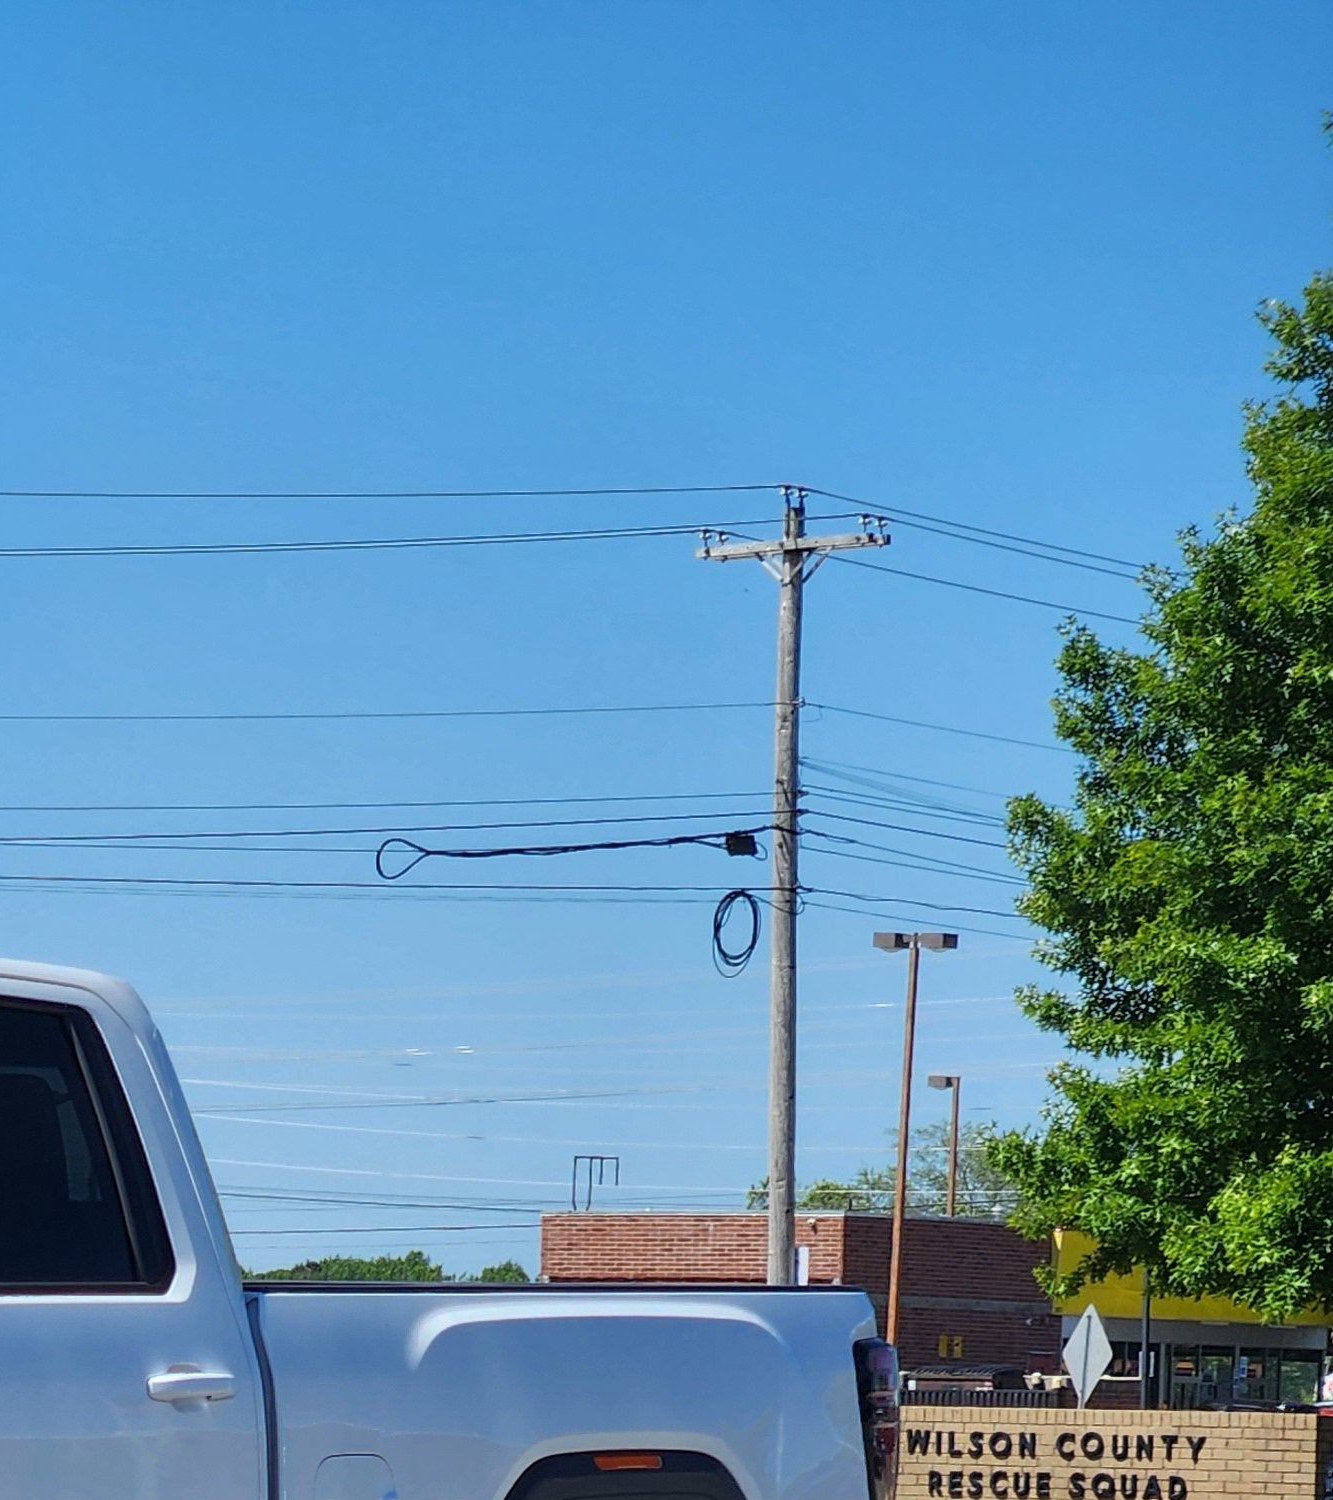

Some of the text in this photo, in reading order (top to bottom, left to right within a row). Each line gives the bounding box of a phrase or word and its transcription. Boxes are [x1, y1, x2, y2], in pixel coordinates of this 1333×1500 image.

[906, 1428, 1208, 1465] WILSON COUNTY
[927, 1470, 1052, 1500] RESCUE
